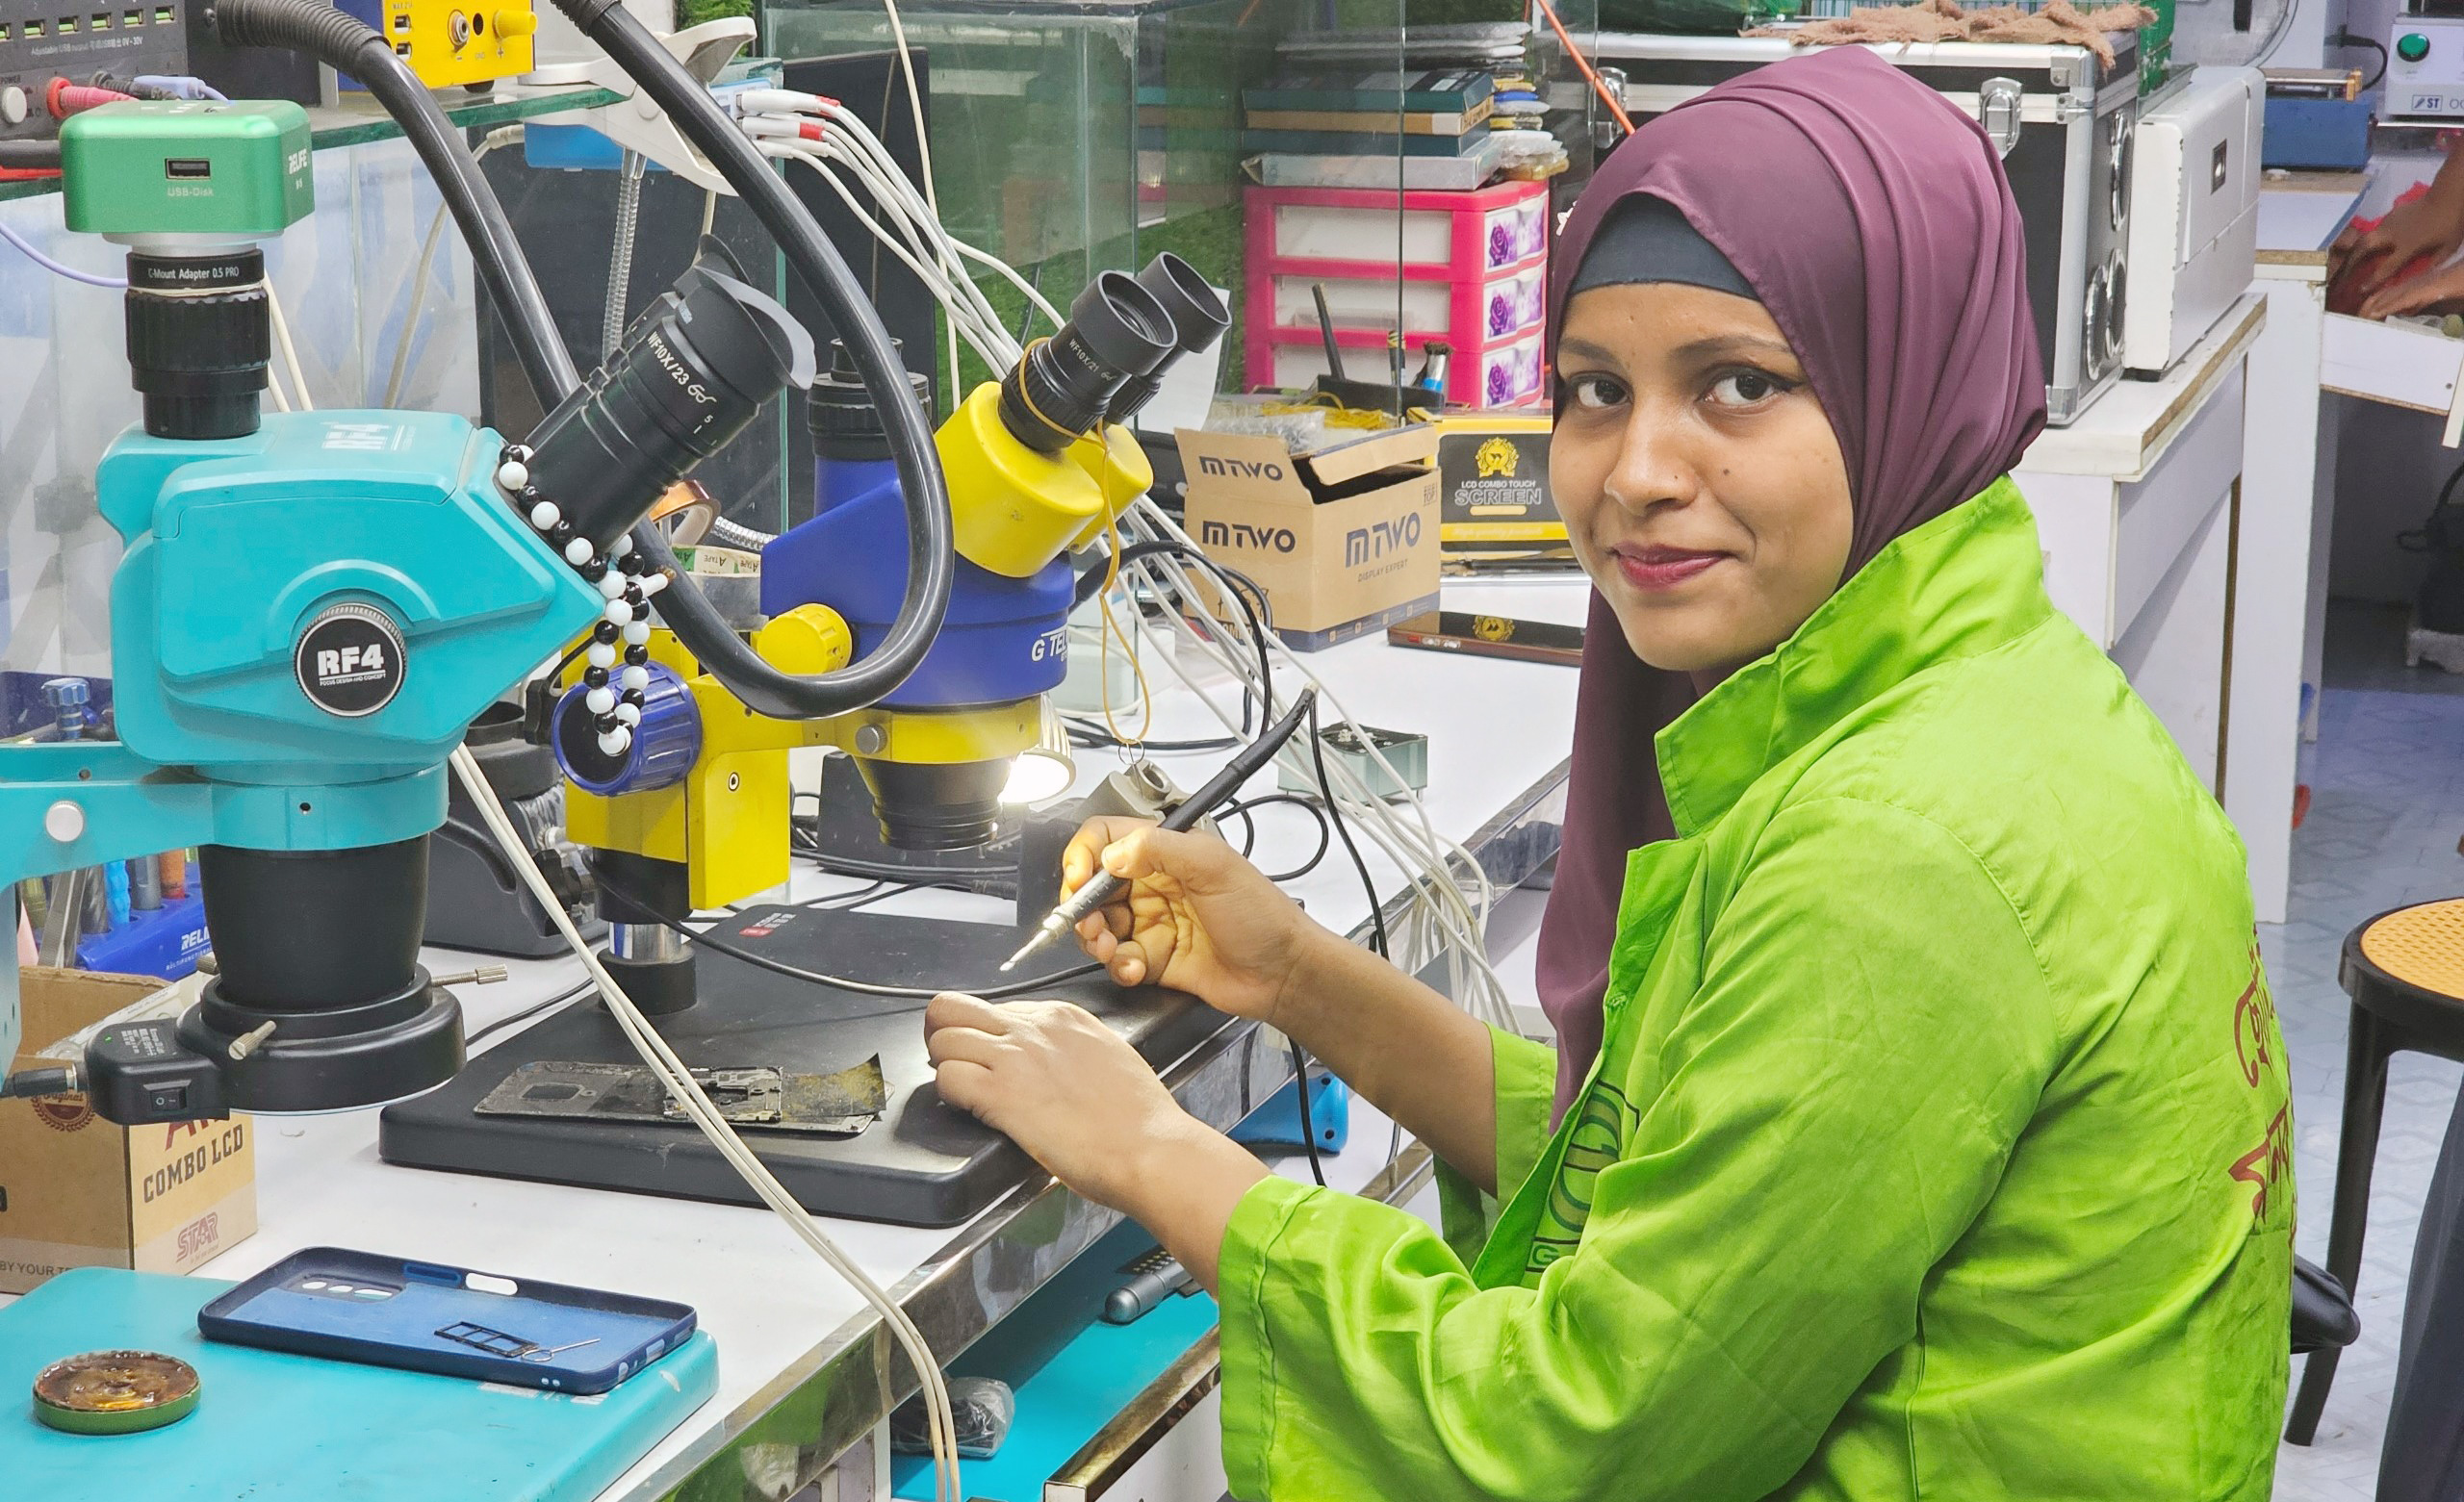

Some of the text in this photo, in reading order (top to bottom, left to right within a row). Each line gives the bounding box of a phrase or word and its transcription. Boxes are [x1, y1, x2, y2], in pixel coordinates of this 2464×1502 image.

[2426, 97, 2440, 109] ST
[289, 148, 308, 175] RELIFE
[167, 187, 214, 197] USB-Disk
[148, 266, 240, 283] C-Mount Adapter 0.5 PRO
[647, 330, 690, 386] WF10X/23
[1069, 338, 1099, 372] WF10X/21
[704, 414, 714, 423] 5
[1198, 455, 1283, 481] MTWO
[1461, 479, 1536, 489] LCD COMBO TOUCH
[1454, 488, 1542, 506] SCREEN
[1202, 520, 1296, 553] MTWO
[1345, 511, 1421, 569] MTWO
[1357, 558, 1408, 583] DISPLAY EXPERT
[317, 643, 385, 676] RF4
[1032, 639, 1045, 661] G
[320, 677, 336, 687] FOCUS
[364, 673, 386, 682] CONCEPT
[181, 926, 211, 951] RELI
[143, 1145, 206, 1204] COMBO
[211, 1123, 244, 1165] LCD
[175, 1211, 218, 1262] STAR
[17, 1261, 55, 1276] YOUR
